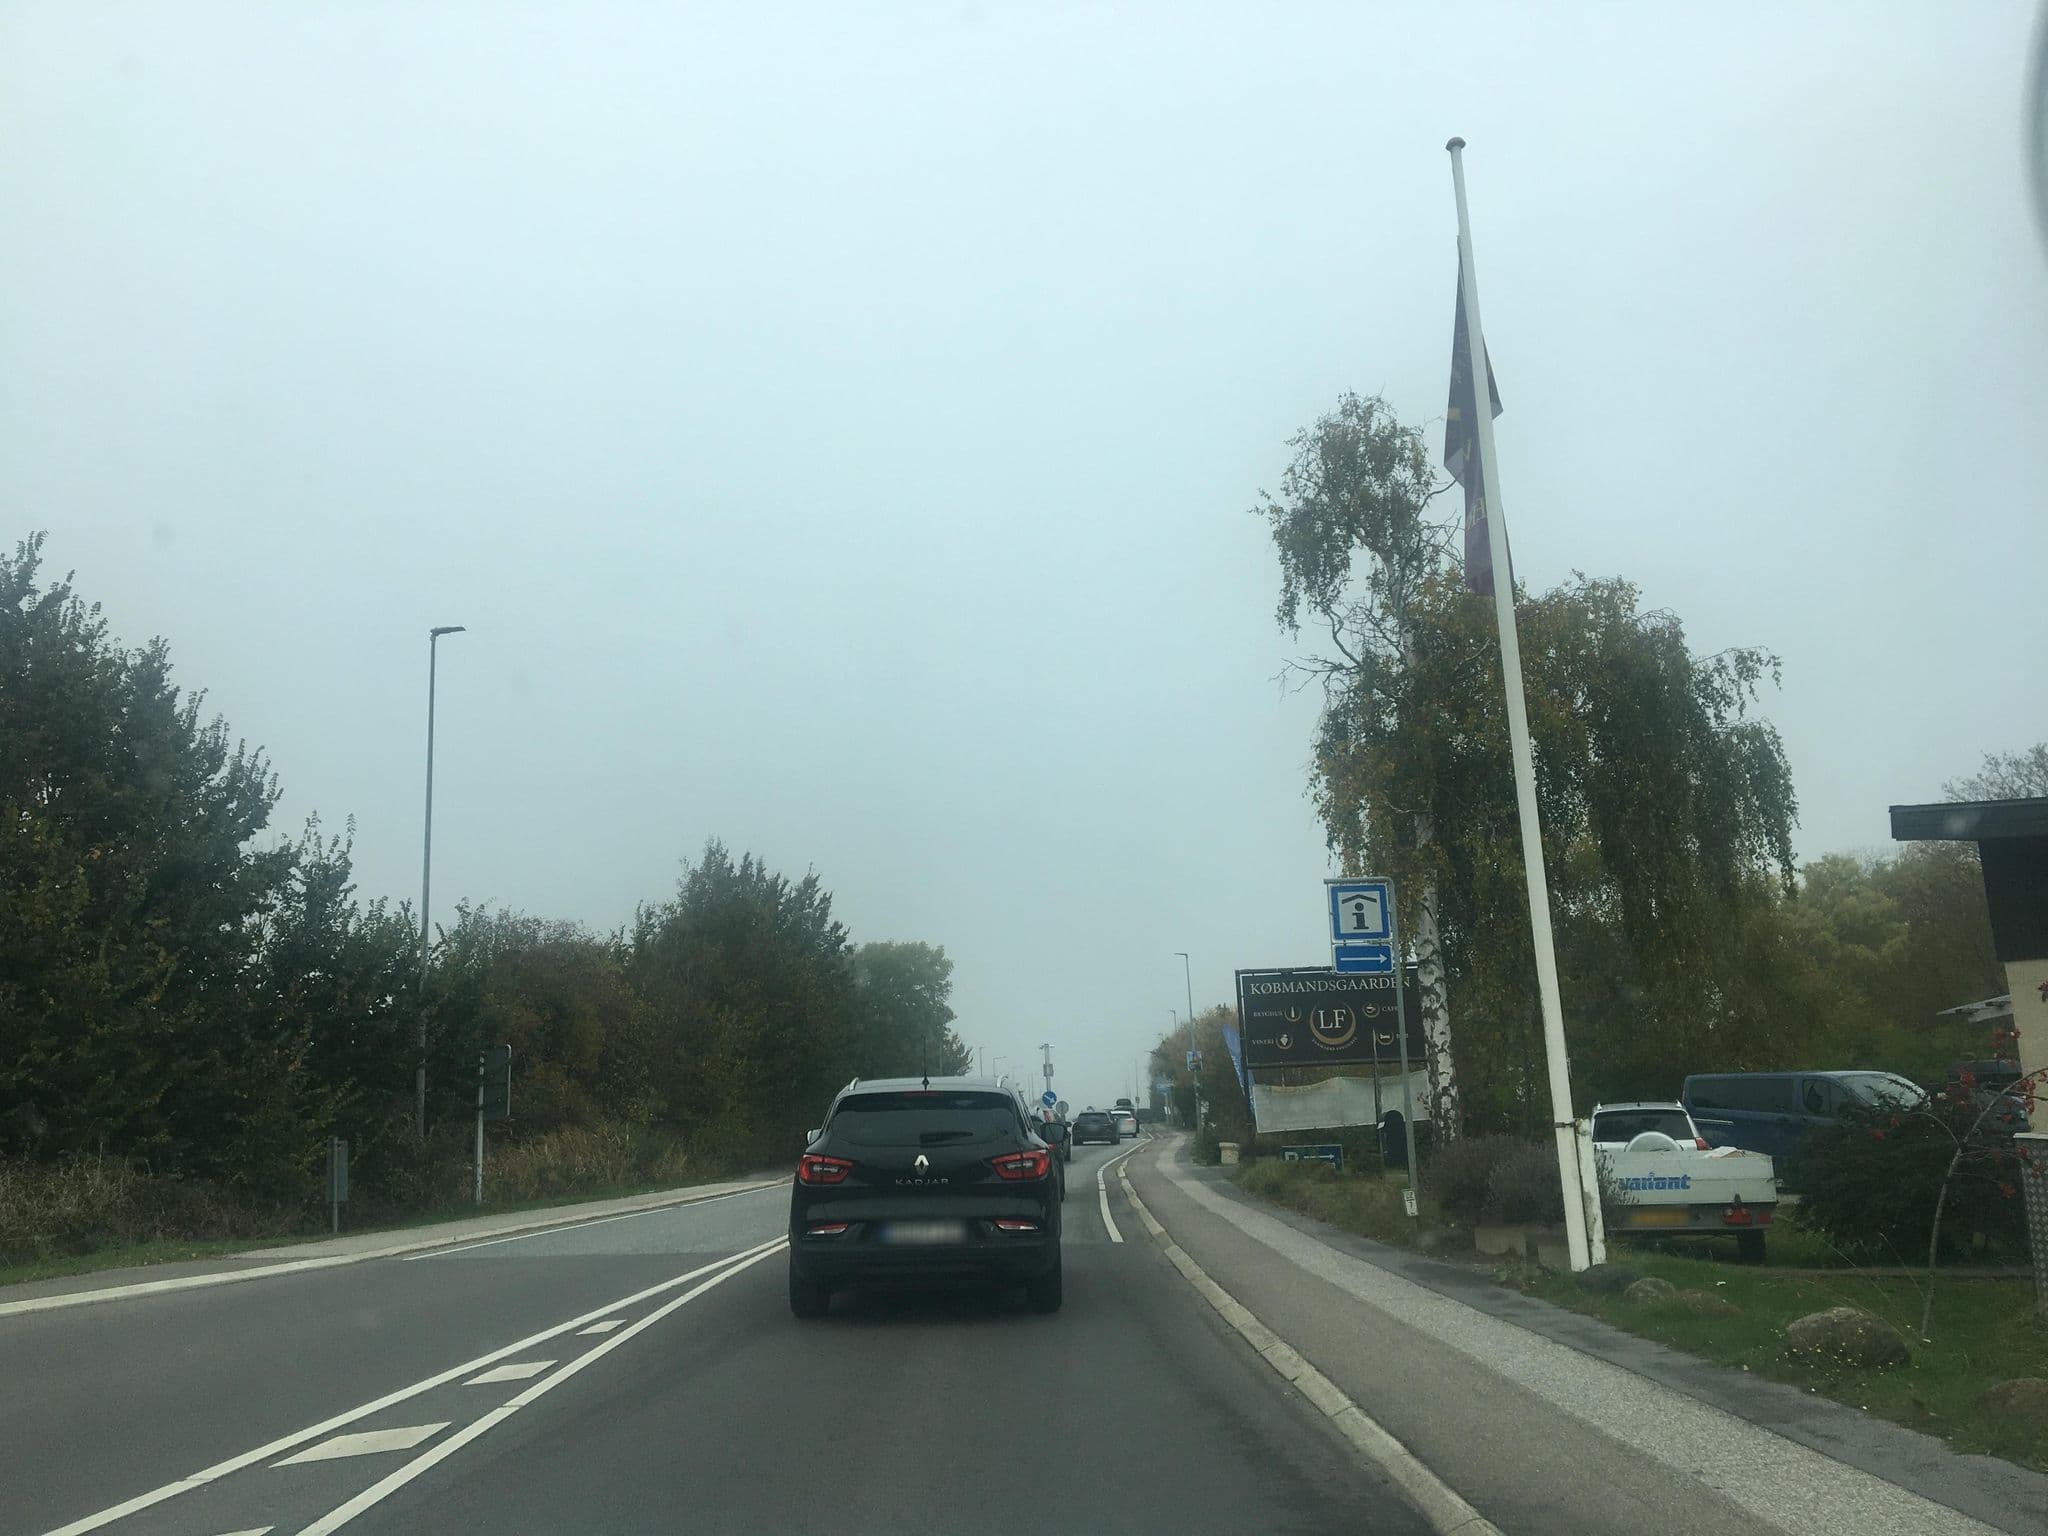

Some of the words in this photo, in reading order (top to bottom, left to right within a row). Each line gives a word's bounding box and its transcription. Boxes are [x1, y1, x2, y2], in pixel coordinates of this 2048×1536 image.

[1250, 976, 1410, 995] KØBMANDSGAARDEN
[1318, 1009, 1347, 1029] LF
[1618, 1171, 1691, 1191] variant
